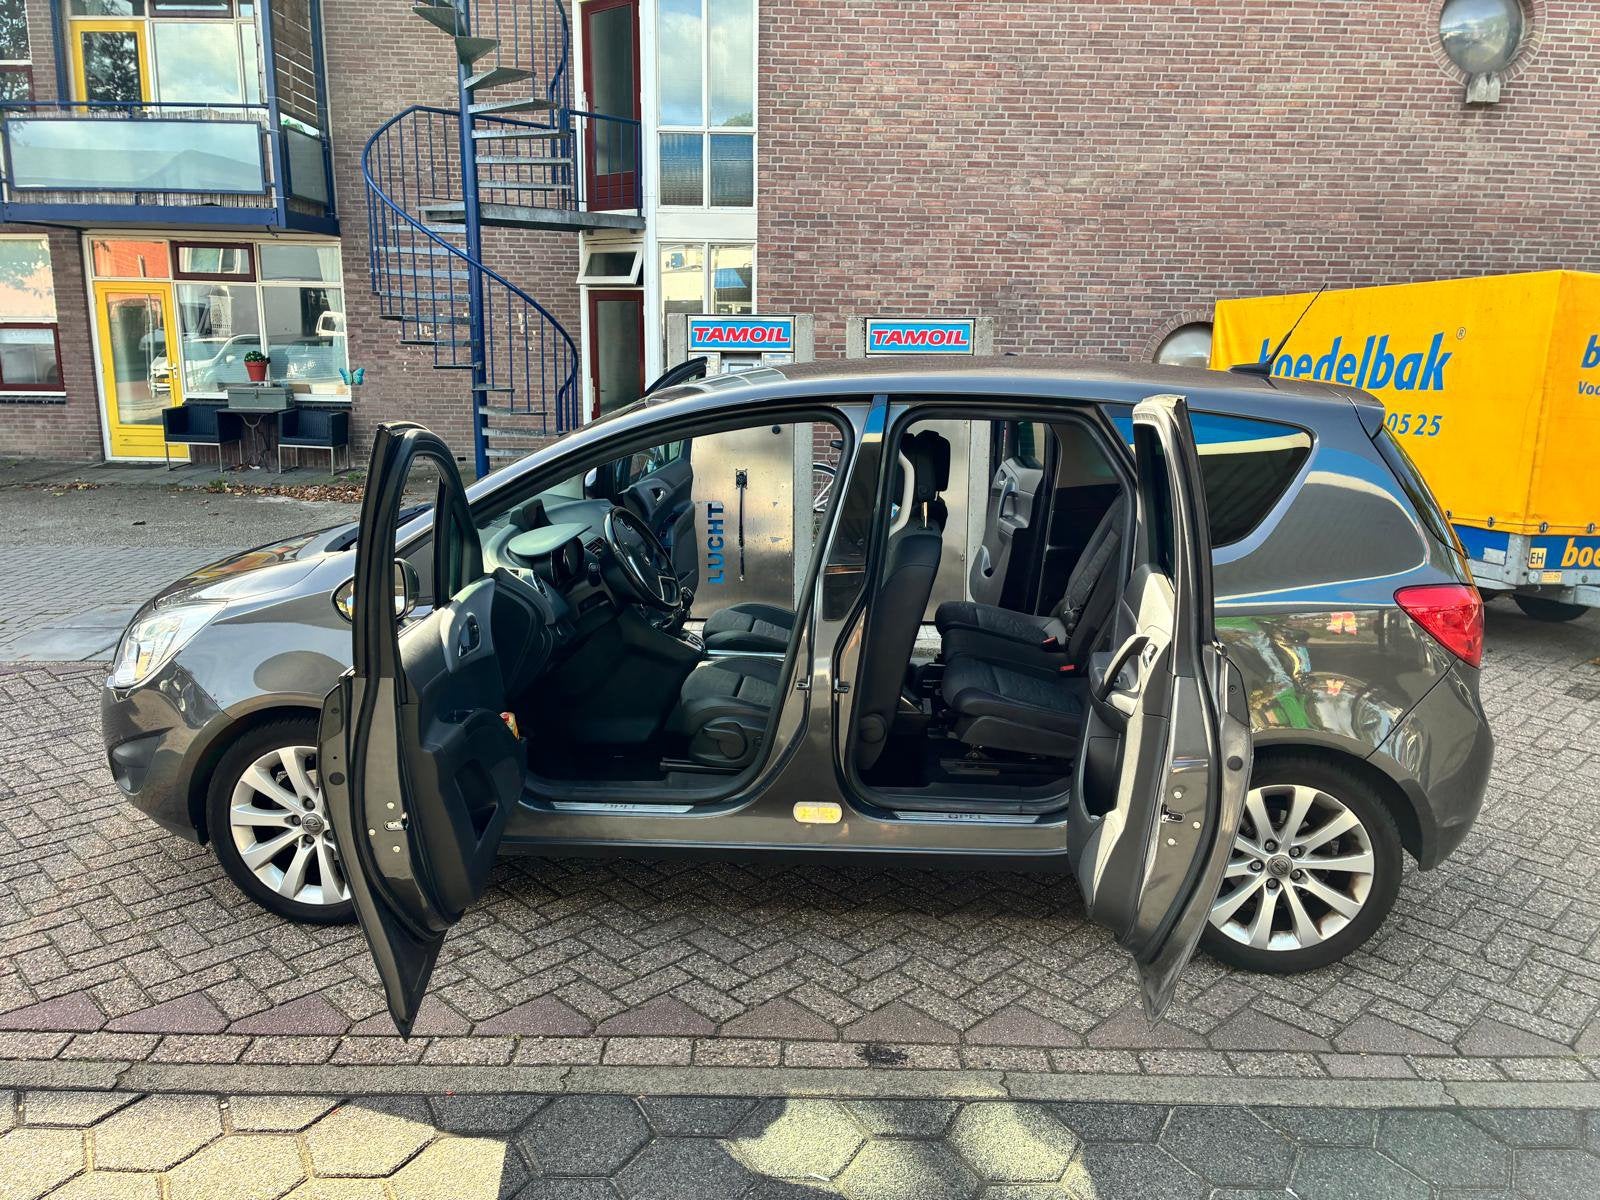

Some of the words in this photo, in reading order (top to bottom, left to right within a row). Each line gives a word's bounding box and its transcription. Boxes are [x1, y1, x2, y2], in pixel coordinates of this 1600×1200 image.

[693, 327, 789, 343] TAMOIL
[872, 329, 968, 346] TAMOIL
[707, 503, 724, 584] LUCHT
[1530, 552, 1544, 565] EH
